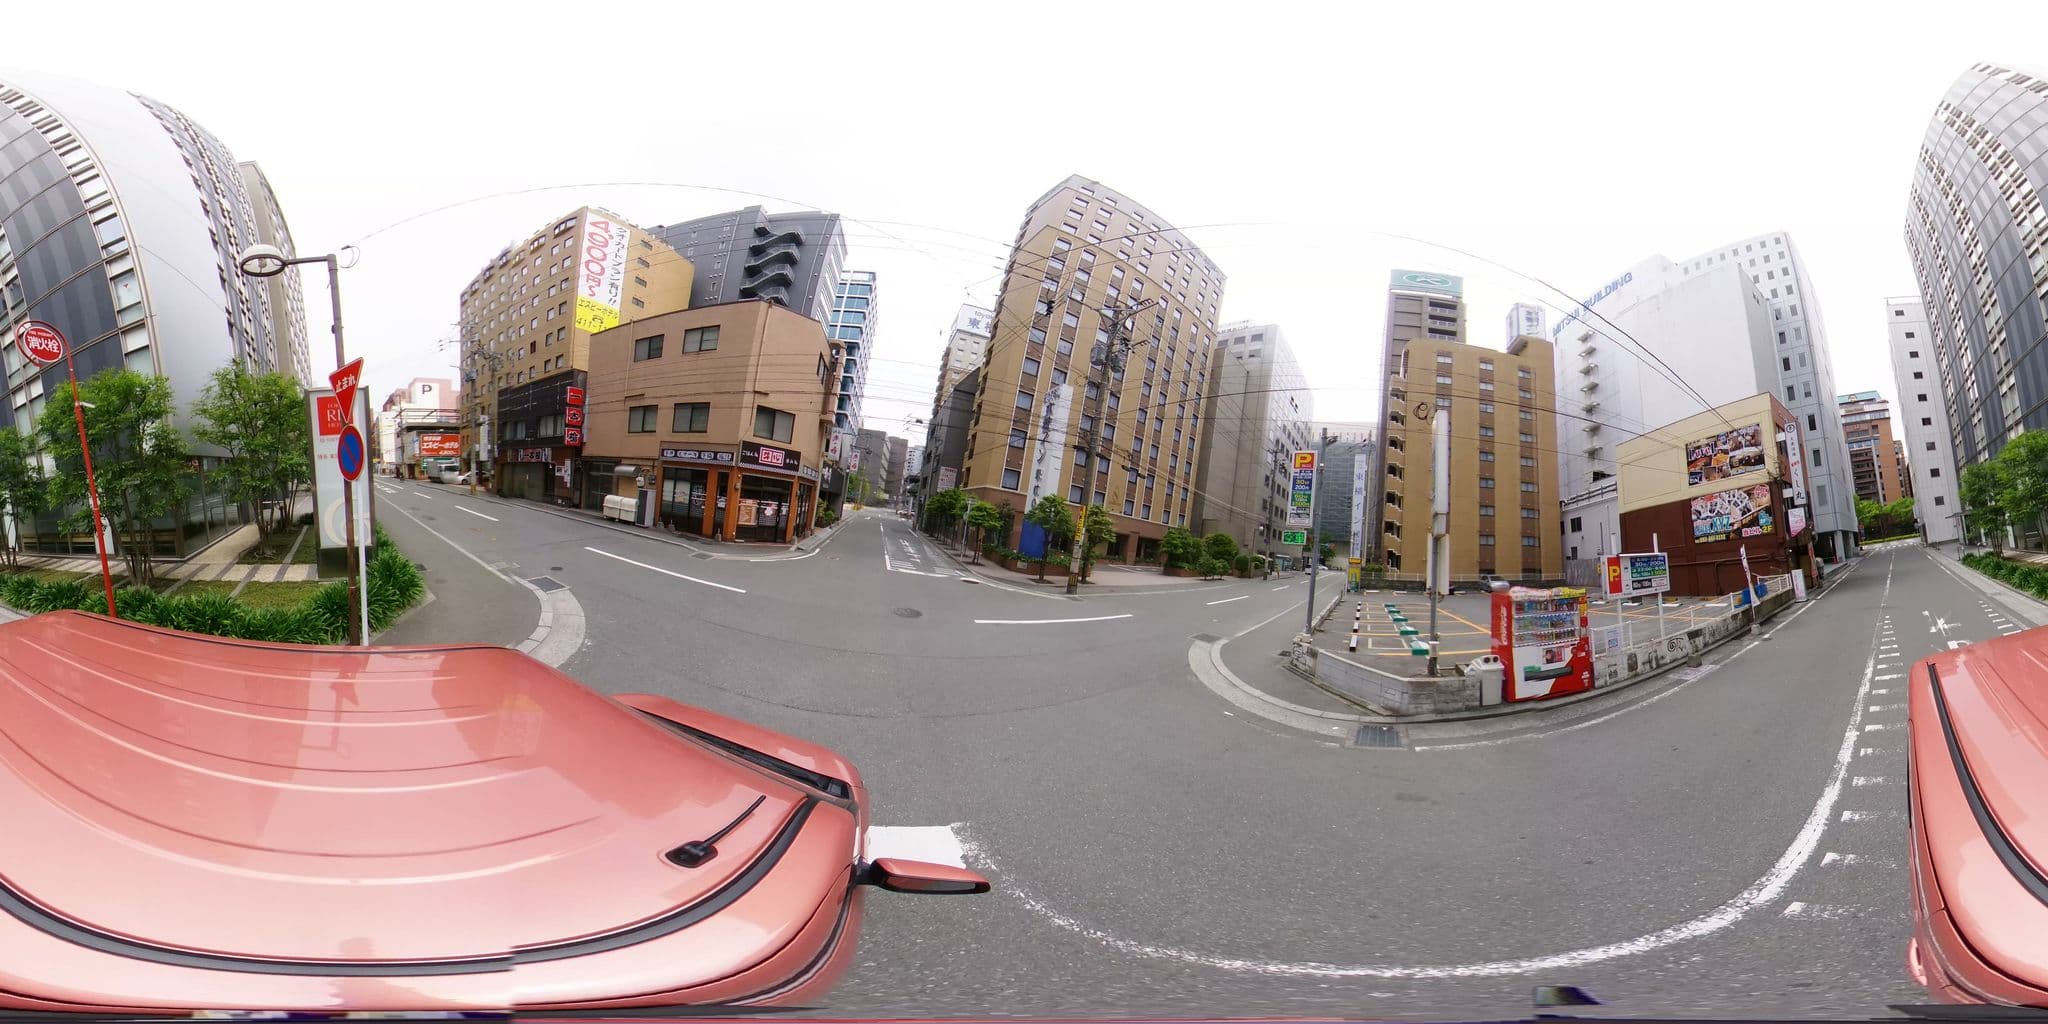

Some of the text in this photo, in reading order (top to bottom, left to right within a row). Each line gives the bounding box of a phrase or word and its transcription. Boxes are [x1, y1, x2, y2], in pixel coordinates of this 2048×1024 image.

[1553, 307, 1580, 338] MITSUI
[1583, 272, 1632, 312] BUILDING
[27, 335, 60, 353] 消火栓
[336, 374, 356, 392] 止まれ
[422, 384, 432, 394] P
[1295, 454, 1312, 469] P
[1793, 468, 1805, 500] くし丸
[1712, 517, 1732, 531] XYZ
[1761, 525, 1773, 533] 2F
[1609, 566, 1619, 582] P
